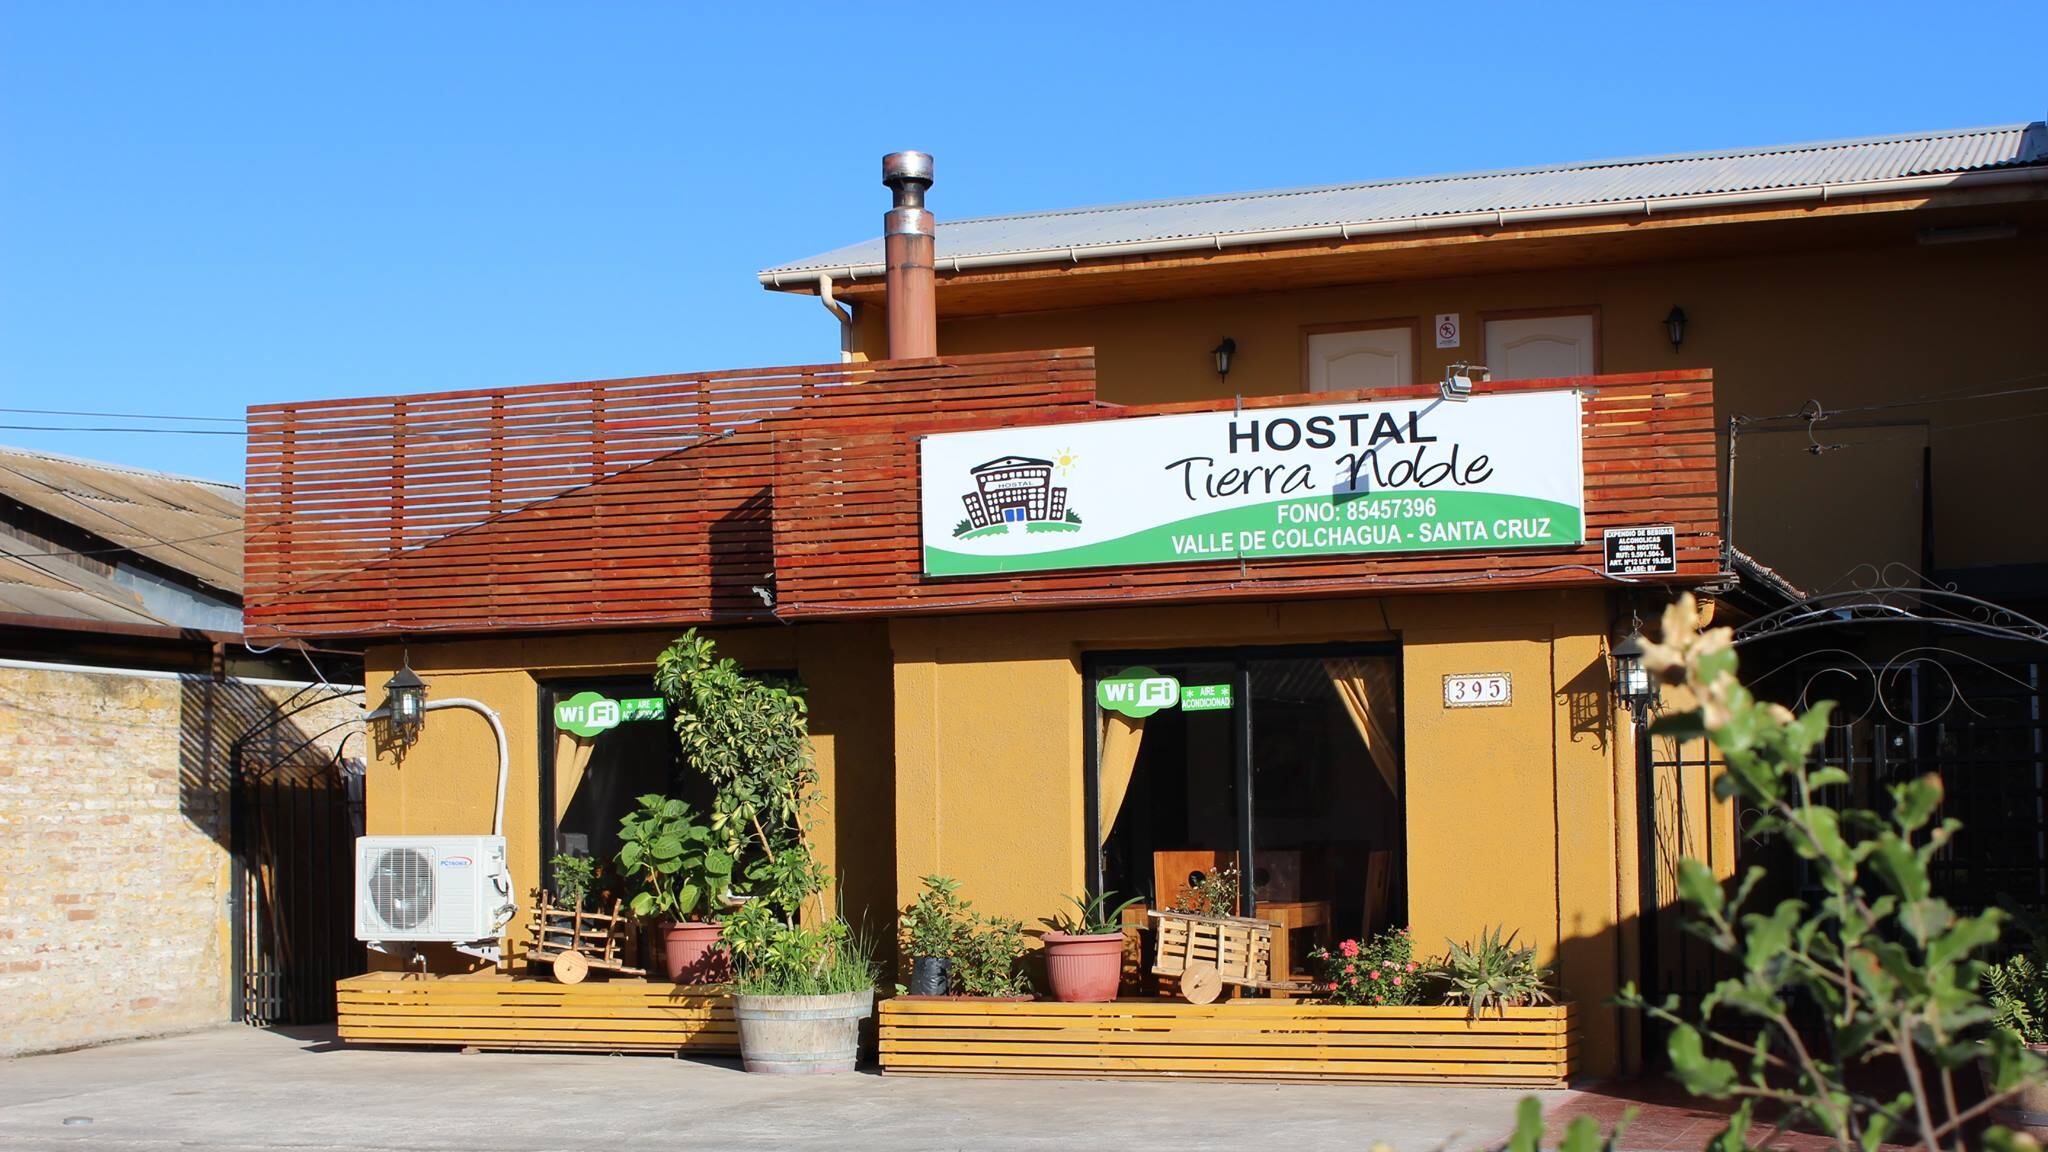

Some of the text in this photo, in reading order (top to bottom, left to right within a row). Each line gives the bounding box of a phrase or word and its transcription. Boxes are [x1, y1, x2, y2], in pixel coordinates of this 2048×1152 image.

[1229, 411, 1437, 453] HOSTAL
[998, 481, 1033, 489] HOSTAL
[1165, 443, 1493, 500] Tierra Noble
[1277, 497, 1437, 524] FONO: 85457396
[1171, 532, 1234, 554] VALLE
[1240, 530, 1266, 550] DE
[1272, 524, 1402, 550] COLCHAGUA
[1418, 520, 1488, 543] SANTA
[1493, 517, 1552, 539] CRUZ
[1200, 686, 1216, 696] AIRE
[1456, 680, 1500, 699] 395
